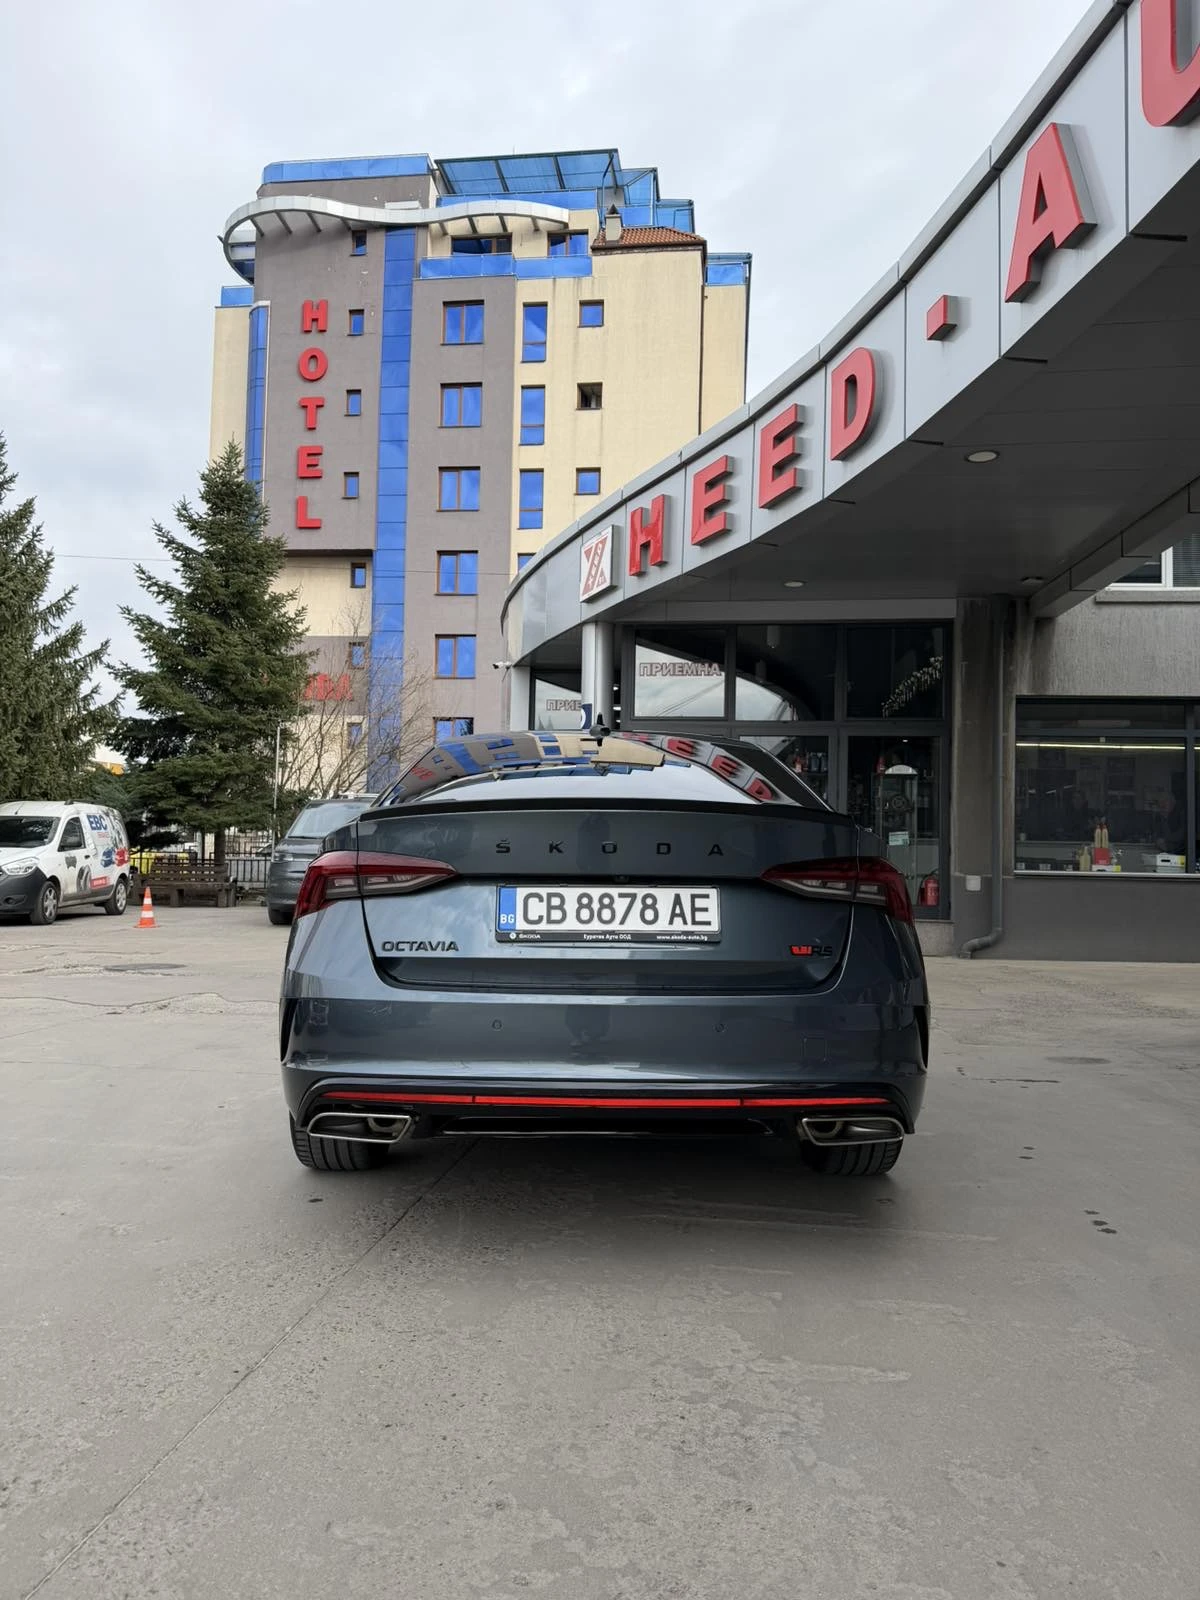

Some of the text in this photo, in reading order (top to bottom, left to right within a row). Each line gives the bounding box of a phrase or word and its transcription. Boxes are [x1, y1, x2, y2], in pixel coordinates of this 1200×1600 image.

[296, 300, 329, 529] HOTEL
[639, 662, 722, 677] ПРИЕМНА
[86, 814, 108, 831] EBC
[495, 839, 724, 857] ŠKODA
[522, 892, 712, 926] CB 8878 AE
[500, 914, 515, 924] BG
[381, 940, 460, 952] OCTAVIA
